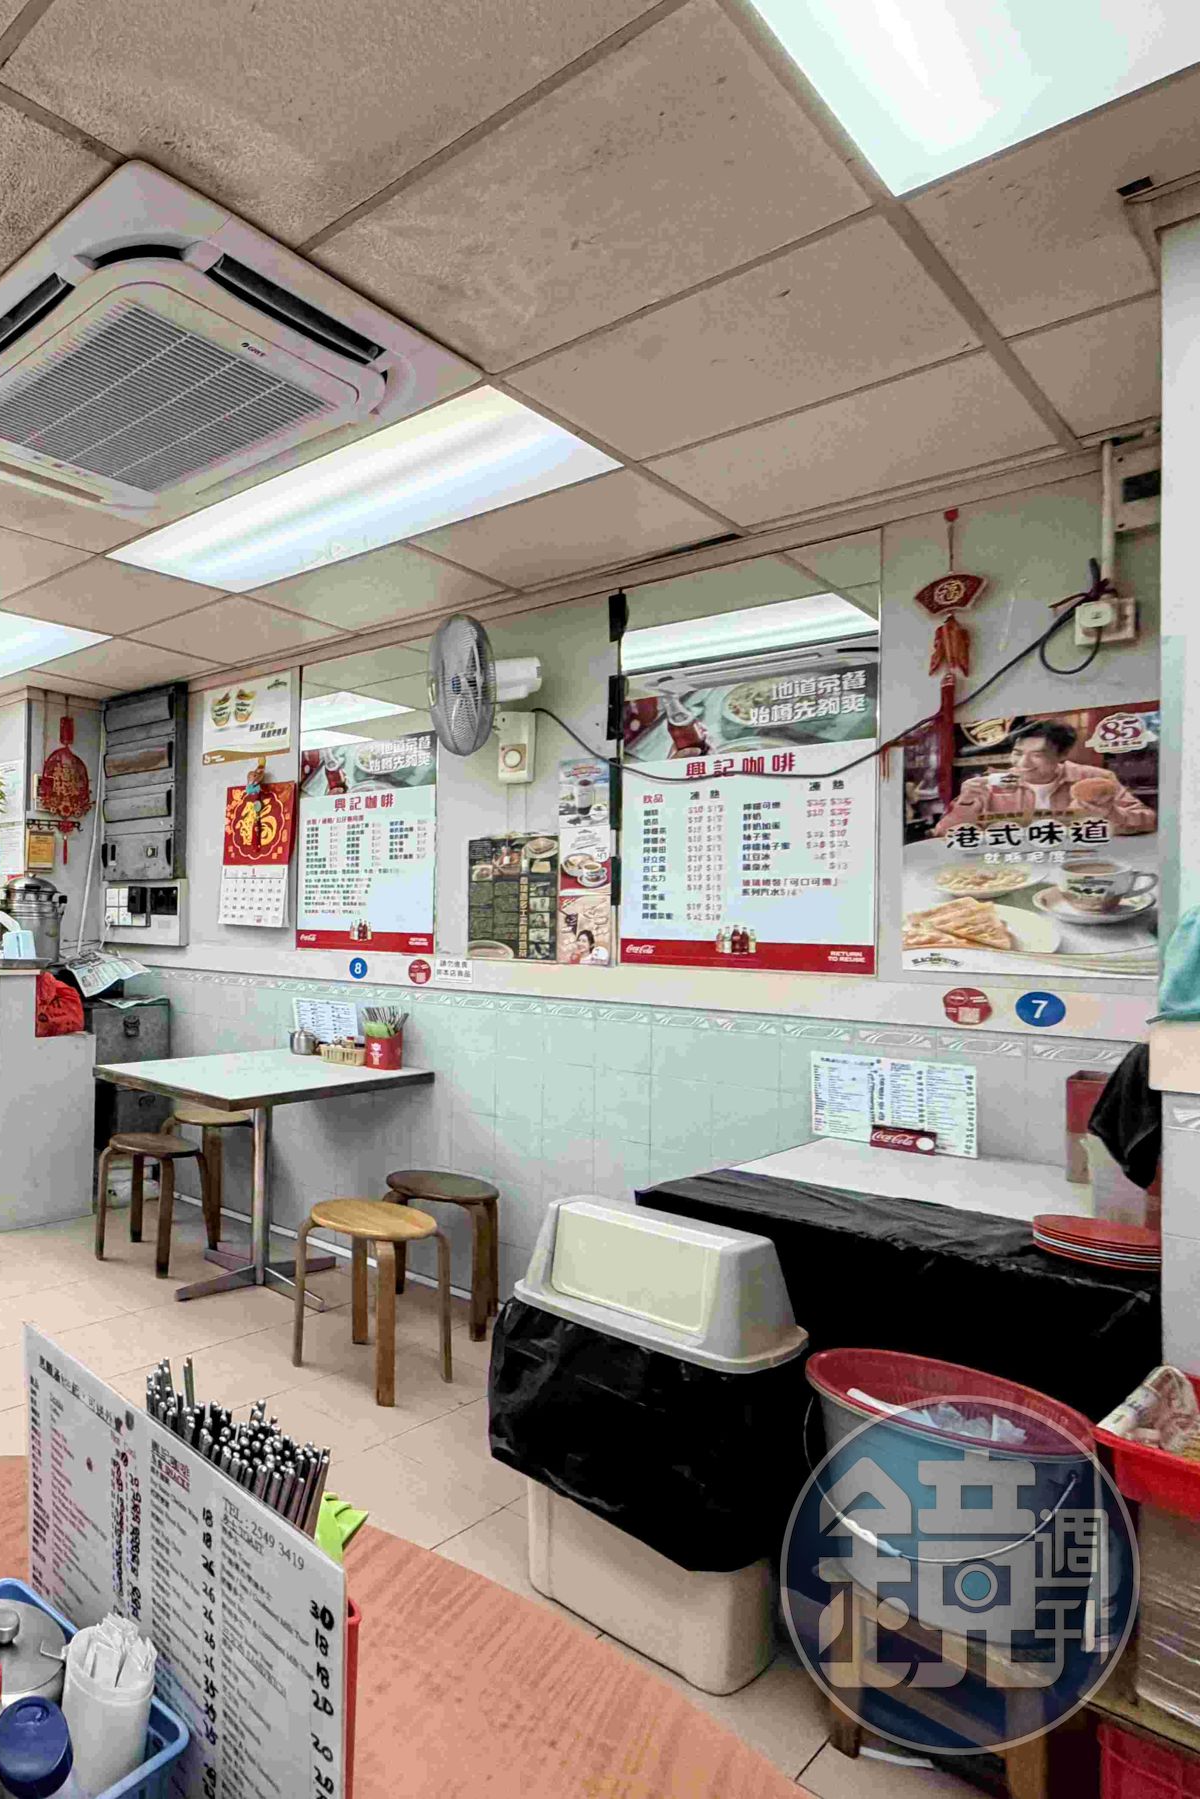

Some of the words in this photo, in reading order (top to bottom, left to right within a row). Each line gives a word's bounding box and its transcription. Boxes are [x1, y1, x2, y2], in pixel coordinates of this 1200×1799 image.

[772, 669, 867, 701] 地道茶餐
[1100, 718, 1142, 741] 85
[686, 752, 796, 780] 興記咖啡
[947, 819, 1110, 849] 港式味道
[354, 963, 362, 975] 8
[1031, 1000, 1048, 1019] 7
[872, 1130, 916, 1146] Coca-Cola
[203, 1507, 213, 1528] 18
[250, 1519, 275, 1551] 2549
[277, 1540, 304, 1574] 3419
[202, 1581, 215, 1604] 26
[202, 1605, 215, 1626] 26
[309, 1599, 335, 1632] 30
[204, 1630, 216, 1650] 26
[315, 1627, 329, 1657] 18
[317, 1661, 330, 1689] 18
[311, 1689, 334, 1716] 20
[311, 1732, 334, 1762] 20
